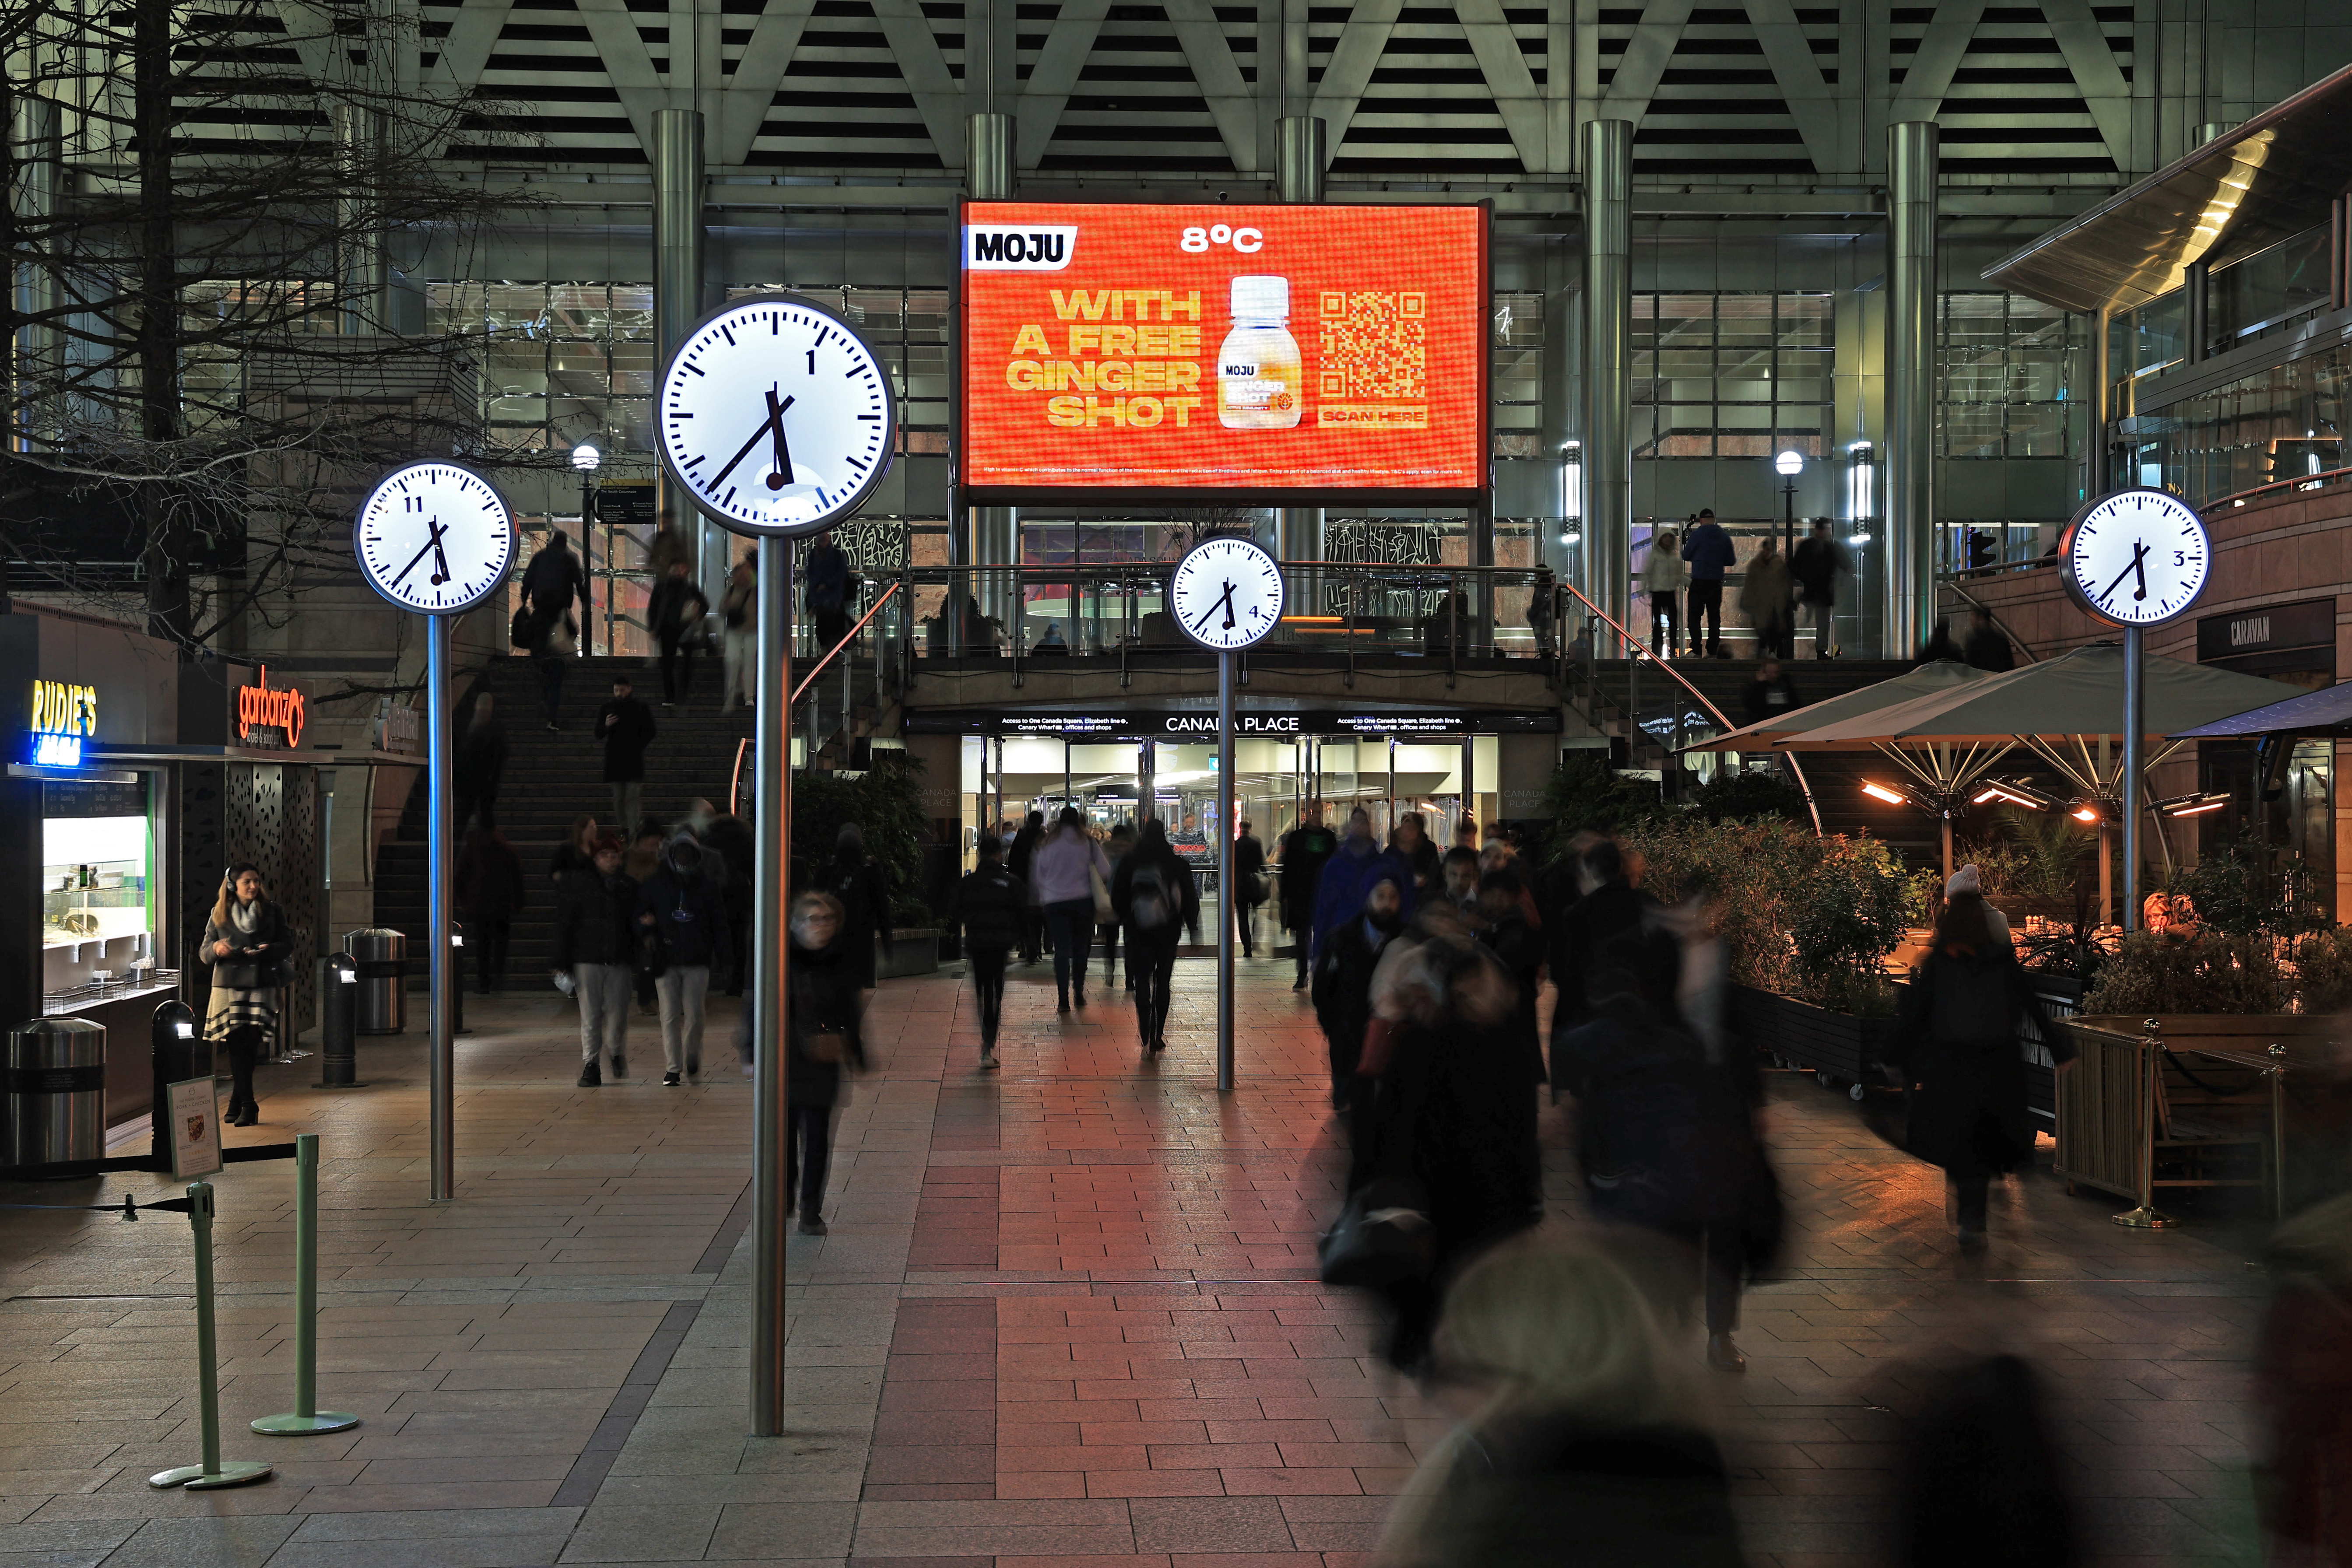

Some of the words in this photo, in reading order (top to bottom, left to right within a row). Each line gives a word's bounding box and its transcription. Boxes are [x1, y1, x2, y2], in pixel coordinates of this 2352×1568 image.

[976, 234, 1064, 263] MOJU
[1050, 289, 1201, 321] WITH
[1010, 324, 1051, 355] A
[1069, 324, 1201, 356] FREE
[806, 350, 815, 375] 1
[1005, 360, 1201, 392] GINGER
[1225, 365, 1254, 376] MOJU
[1225, 381, 1285, 392] GINGER
[1047, 396, 1201, 428] SHOT
[1322, 410, 1374, 423] SCAN
[1378, 410, 1424, 423] HERE
[404, 496, 422, 513] 11
[2173, 551, 2185, 566] 3
[1248, 605, 1259, 618] 4
[2231, 616, 2270, 647] CARAVAN
[32, 679, 97, 737] RUDIE'S
[239, 664, 305, 748] garbanzos
[1245, 717, 1299, 731] PLACE
